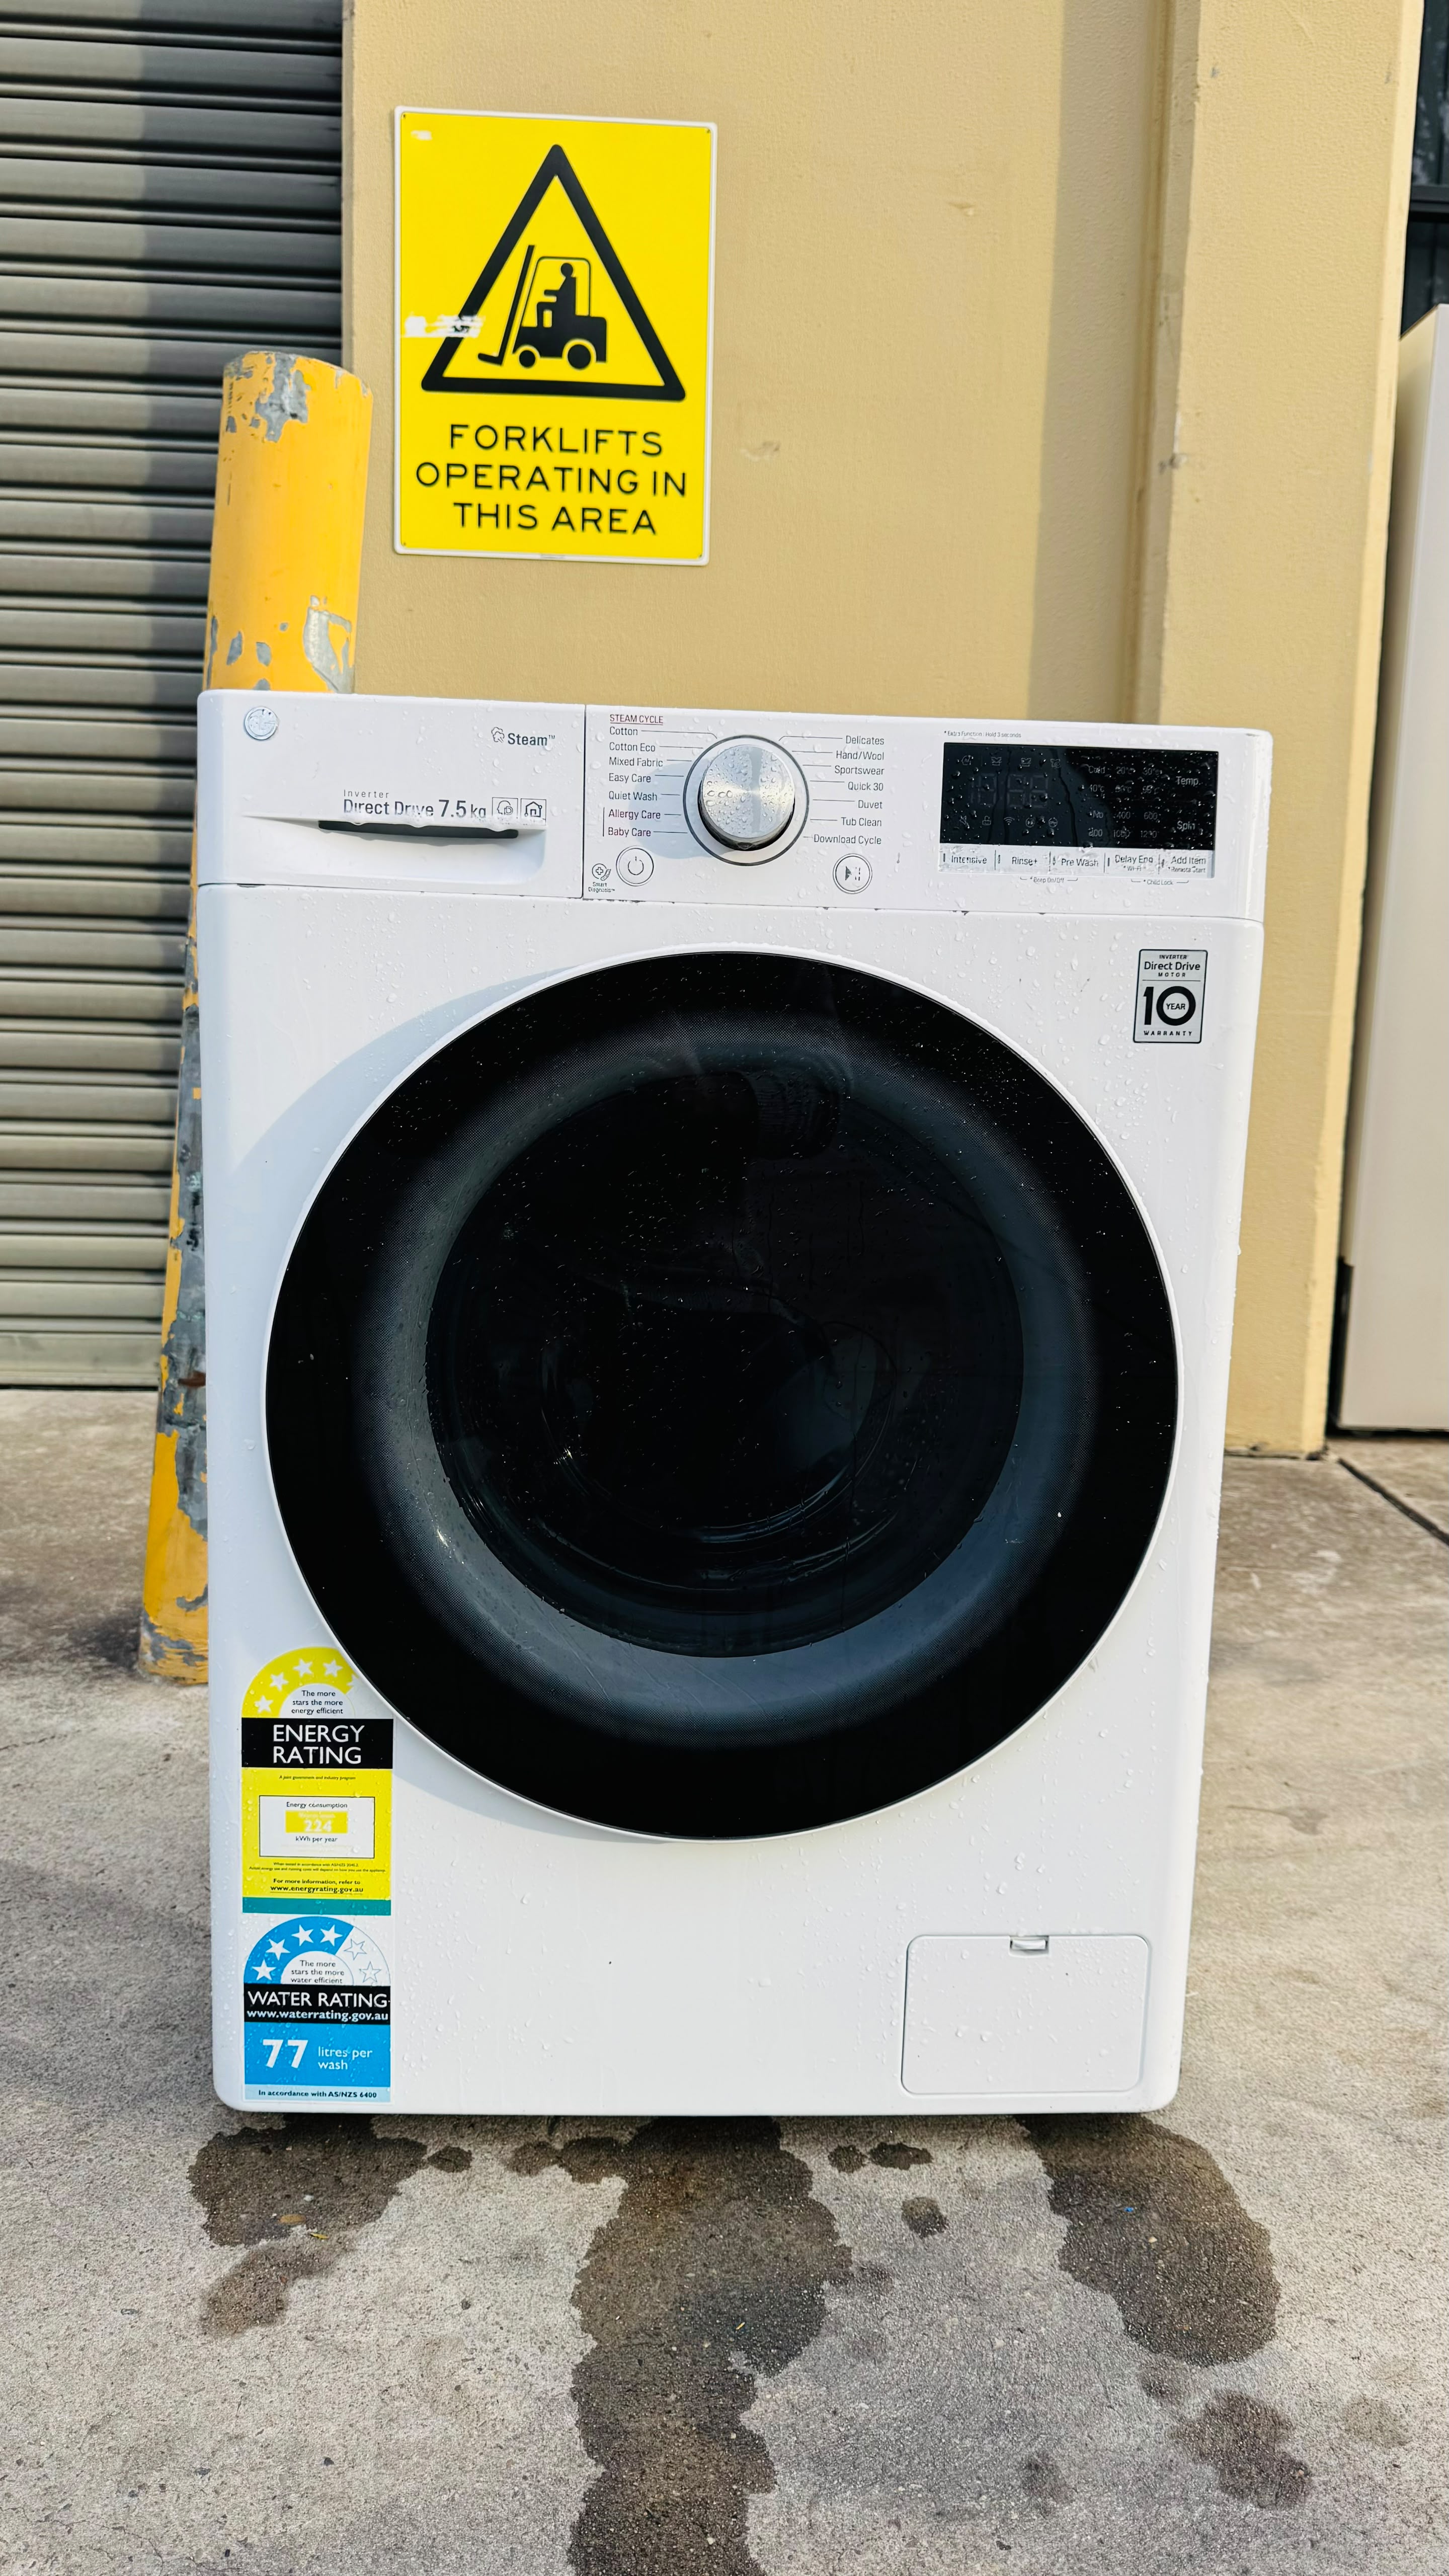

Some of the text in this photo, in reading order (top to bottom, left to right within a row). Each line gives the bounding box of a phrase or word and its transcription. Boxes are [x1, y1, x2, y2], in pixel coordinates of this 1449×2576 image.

[450, 424, 663, 456] FORKLIFTS
[416, 462, 687, 497] OPERATING IN
[453, 502, 657, 535] THIS AREA
[610, 714, 664, 723] STEAM CYCLE
[609, 726, 638, 736] Cotton
[846, 735, 884, 745] Delicates
[609, 742, 656, 752] Cotton Eco
[836, 750, 884, 760] Hand/Wool
[609, 757, 663, 767] Mixed Fabric
[835, 765, 884, 775] Sportswear
[609, 773, 651, 783] Easy Care
[848, 781, 883, 791] Quick 30
[344, 789, 389, 798] Inverter
[609, 791, 657, 801] Quiet Wash
[344, 799, 389, 815] Direct
[394, 801, 434, 817] Drive
[439, 799, 466, 818] 7.5
[858, 800, 883, 809] Duvet
[608, 809, 661, 820] Allergy Care
[841, 817, 882, 827] Tub Clean
[1177, 821, 1195, 831] Spin
[608, 827, 651, 837] Baby Care
[814, 834, 881, 846] Download Cycle
[951, 855, 987, 864] Intensive
[1011, 856, 1038, 866] Rinse+
[1076, 858, 1099, 867] Wash
[1115, 854, 1137, 864] Delay
[1171, 856, 1206, 864] Add Item
[1144, 961, 1200, 971] Direct Drive
[1143, 986, 1196, 1026] 10
[273, 1724, 365, 1743] ENERGY
[273, 1746, 362, 1764] RATING
[270, 1886, 363, 1894] www.energyrating.gov.au
[248, 1991, 388, 2008] WATER RATING
[247, 2009, 388, 2022] www.waterrating.gov.au
[262, 2039, 373, 2068] 77 litres per
[317, 2059, 348, 2070] wash
